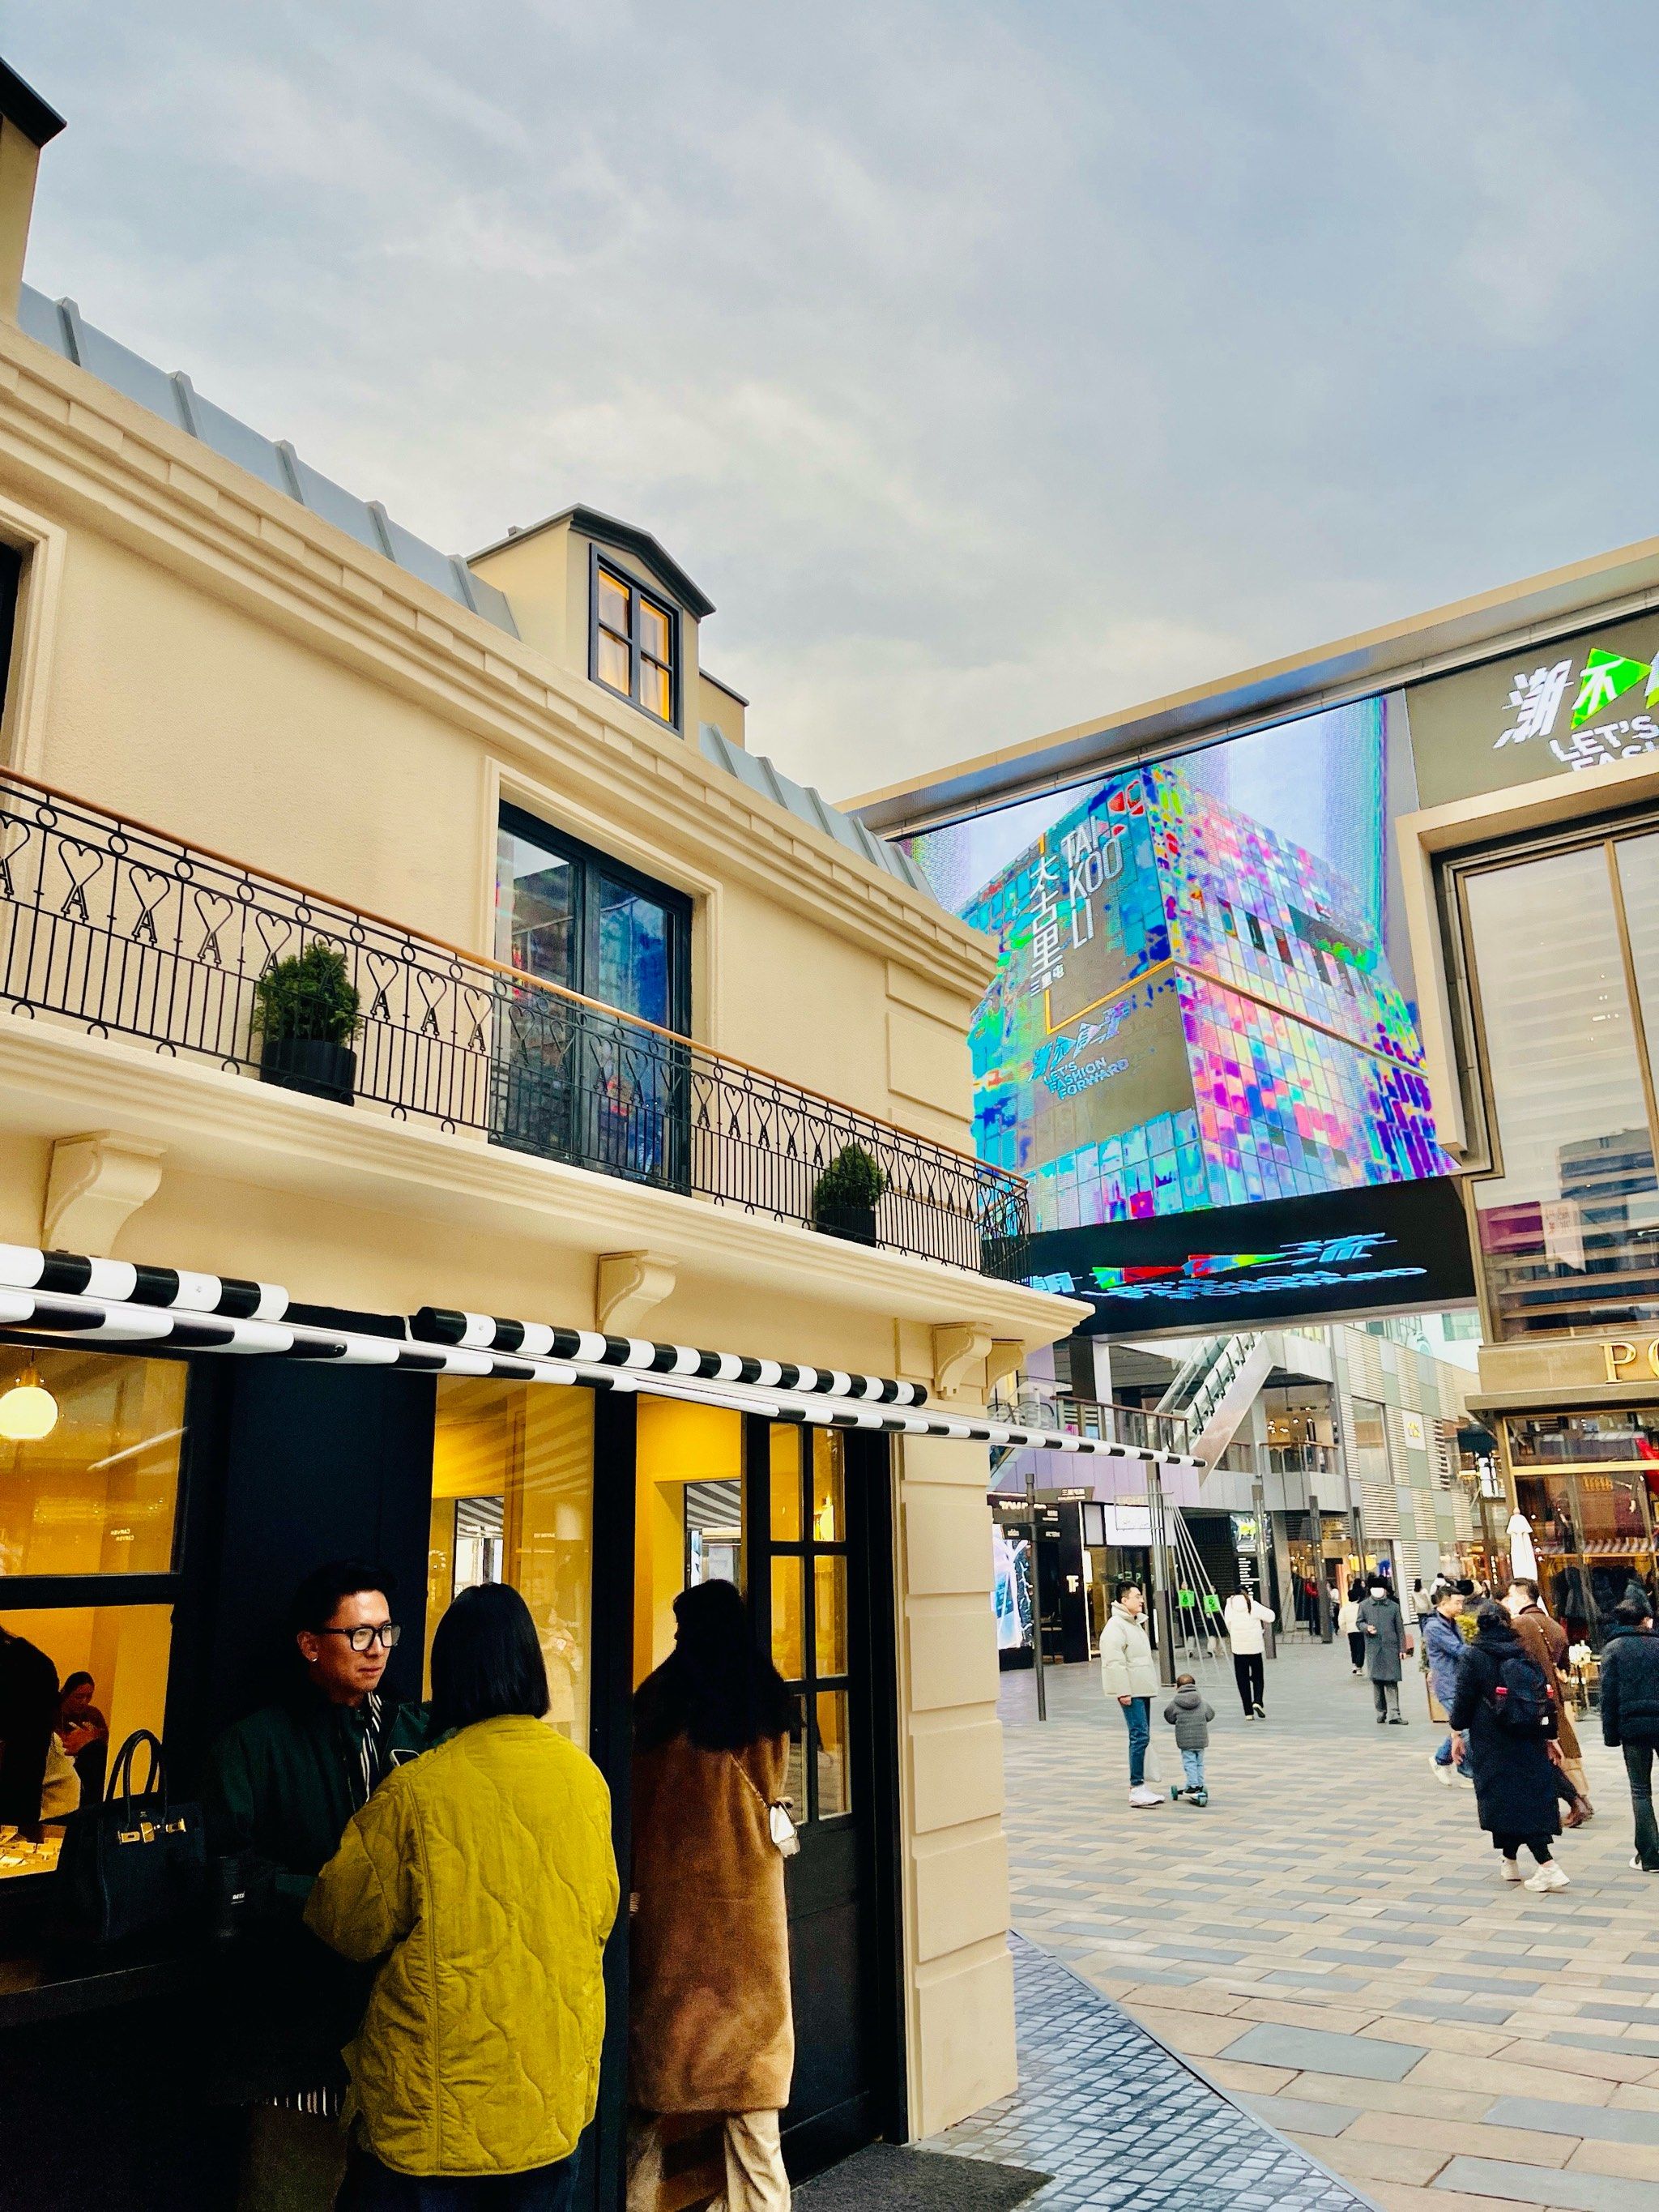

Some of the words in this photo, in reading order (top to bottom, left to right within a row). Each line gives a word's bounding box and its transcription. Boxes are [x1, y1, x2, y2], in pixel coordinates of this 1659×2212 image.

[1549, 715, 1659, 762] LET'S
[1060, 815, 1099, 869] TAI
[1068, 838, 1124, 908] KOO
[1030, 856, 1063, 979] 太古里
[1072, 898, 1094, 950] LI
[1043, 1061, 1077, 1086] LET'S
[1048, 1057, 1107, 1094] FASHION
[1058, 1058, 1130, 1100] FORWARD
